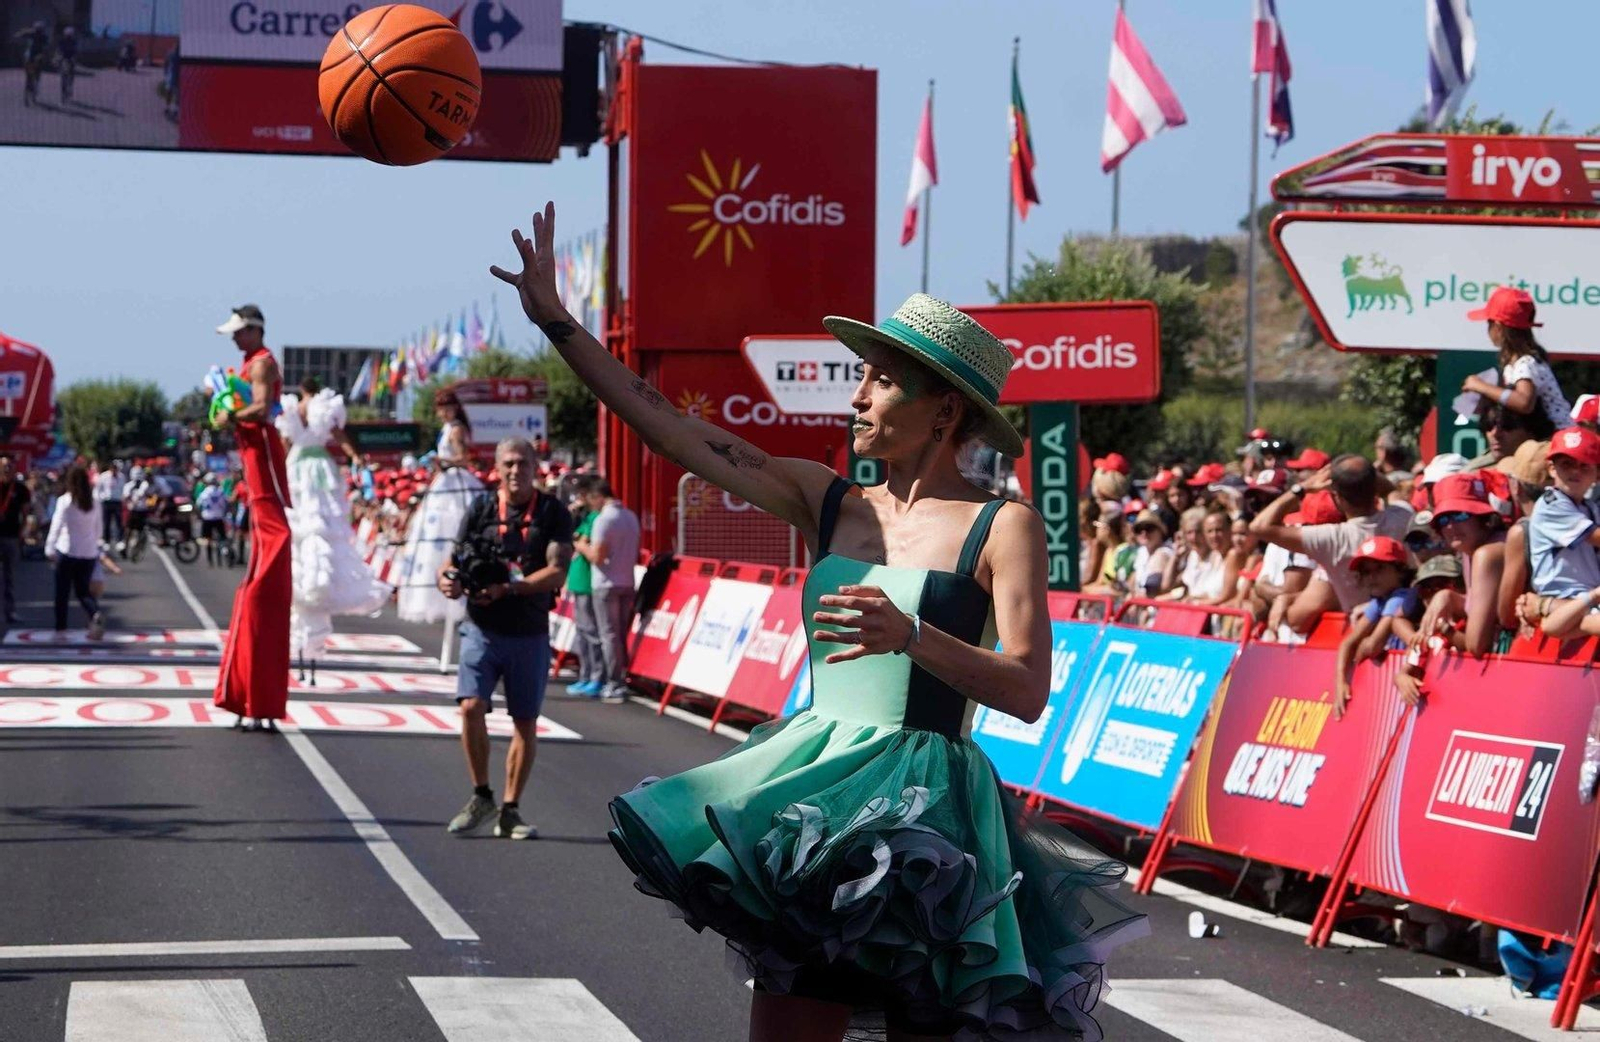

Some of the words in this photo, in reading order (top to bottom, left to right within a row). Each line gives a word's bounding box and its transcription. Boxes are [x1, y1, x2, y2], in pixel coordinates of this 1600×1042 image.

[230, 1, 363, 37] Carref
[1472, 143, 1562, 198] iryo
[713, 193, 846, 226] Cofidis
[823, 362, 865, 382] TIS
[1437, 748, 1471, 804] LA
[1457, 751, 1524, 814] VUELTA
[1515, 760, 1553, 819] 24
